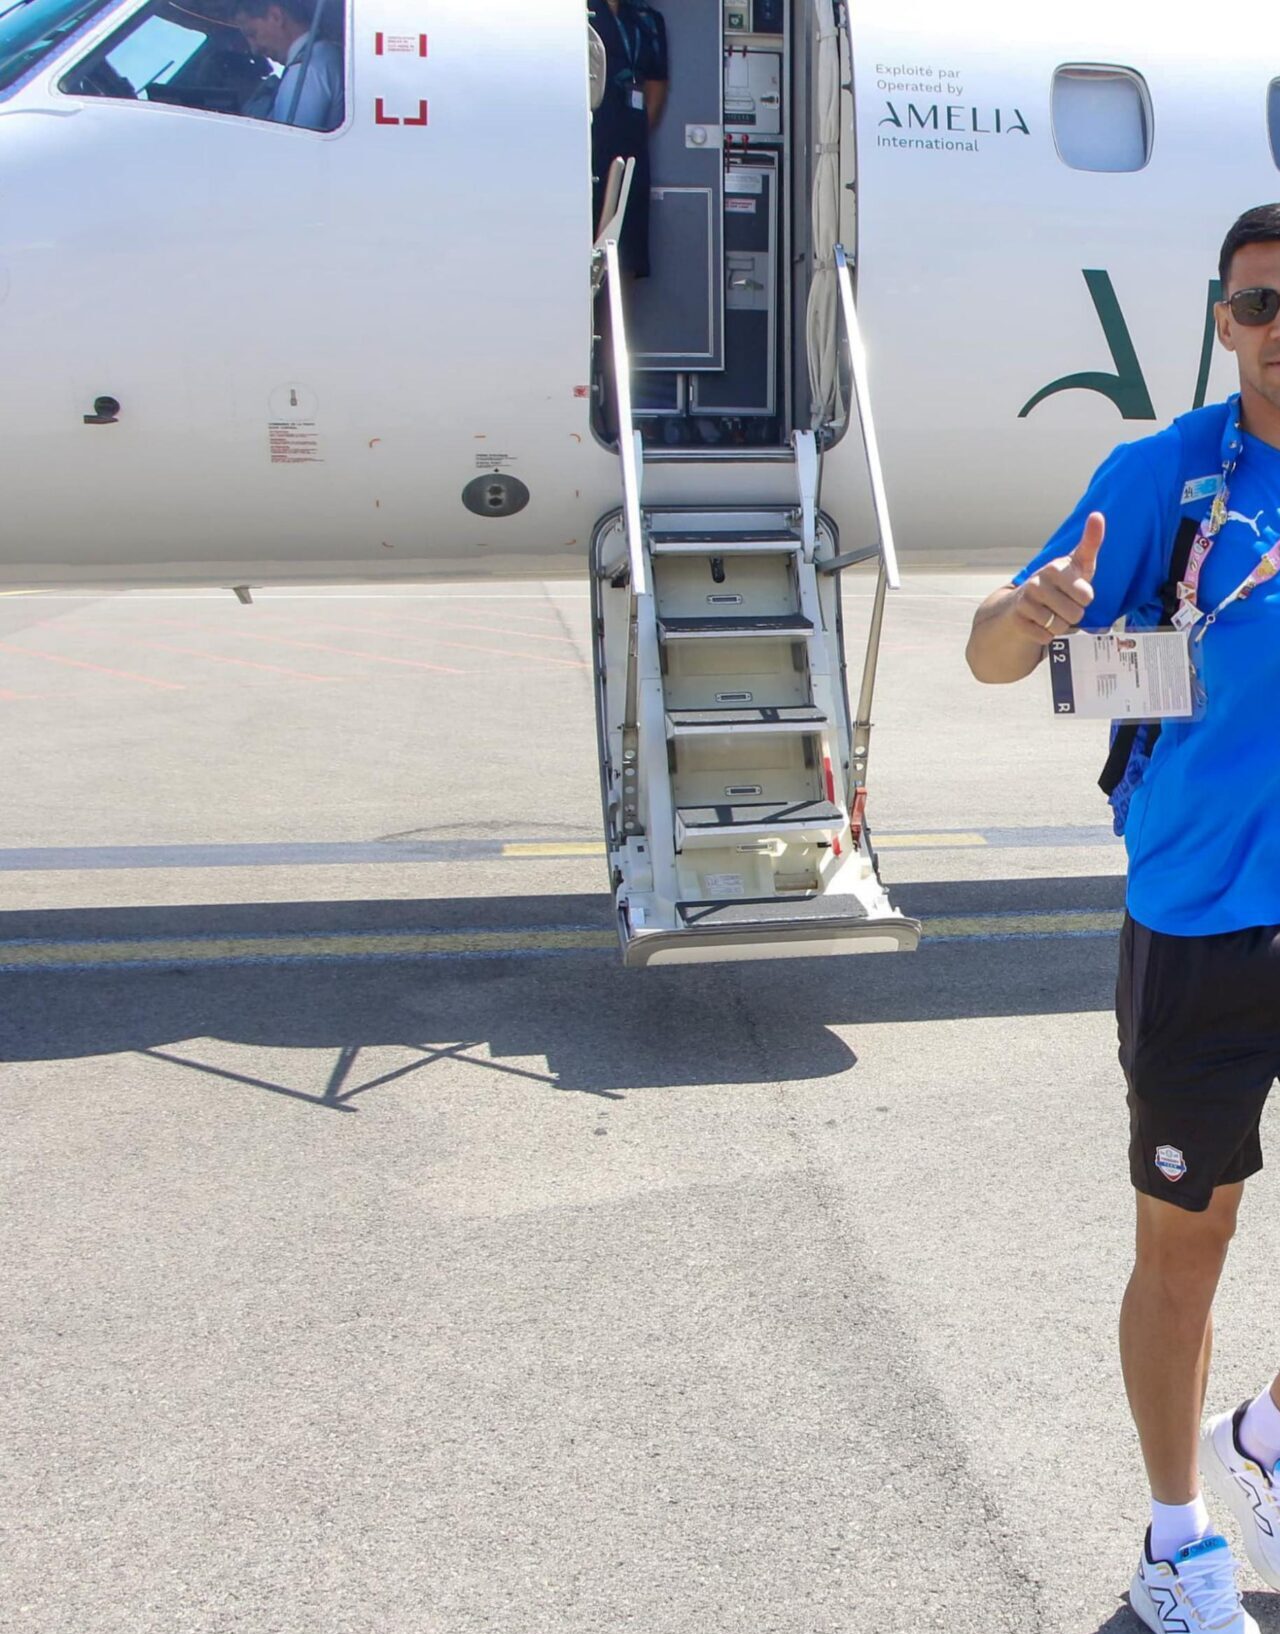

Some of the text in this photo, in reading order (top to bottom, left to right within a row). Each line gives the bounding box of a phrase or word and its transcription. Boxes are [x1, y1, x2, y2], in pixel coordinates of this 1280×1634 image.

[876, 64, 961, 80] Exploité par
[876, 79, 964, 96] Operated by
[878, 101, 1031, 135] AMELIA
[877, 135, 979, 152] International
[1057, 703, 1070, 712] R
